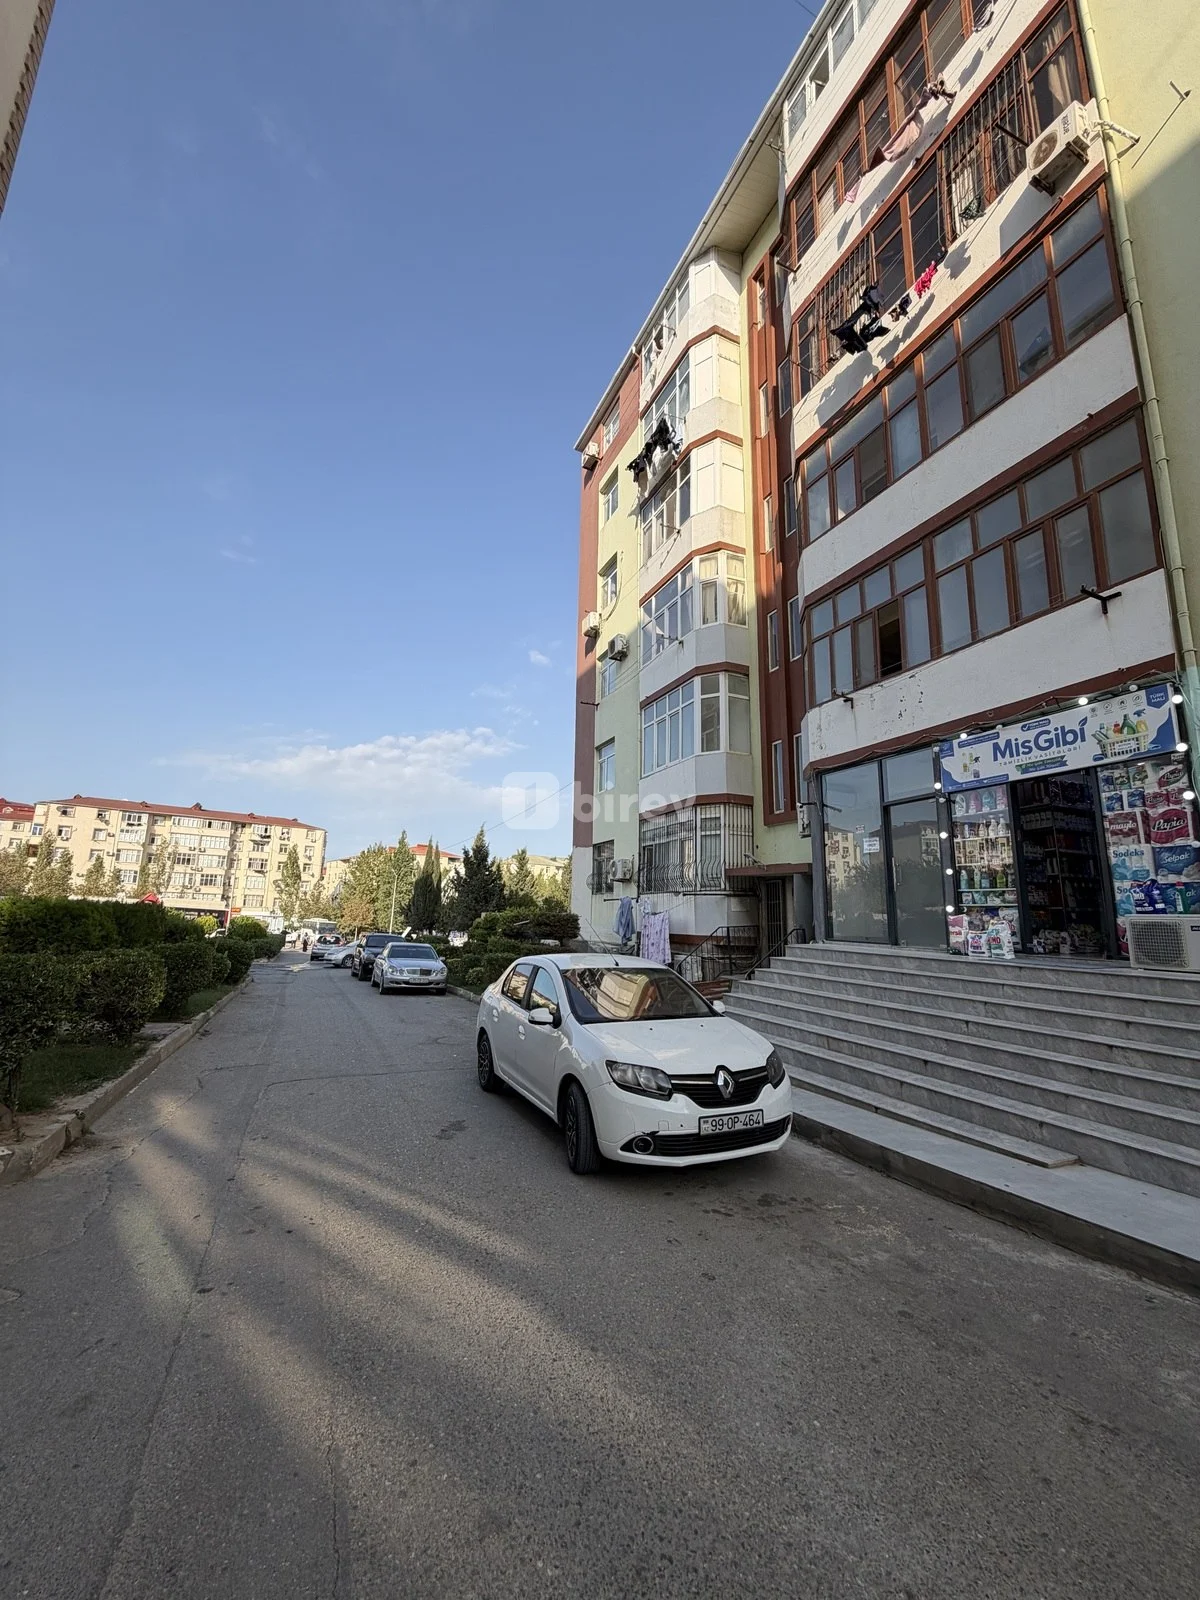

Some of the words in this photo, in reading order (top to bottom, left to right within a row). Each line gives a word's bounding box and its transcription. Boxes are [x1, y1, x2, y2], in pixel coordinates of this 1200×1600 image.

[1154, 817, 1185, 832] Papia
[1112, 848, 1145, 858] Sodeks
[1163, 851, 1190, 863] Selpak
